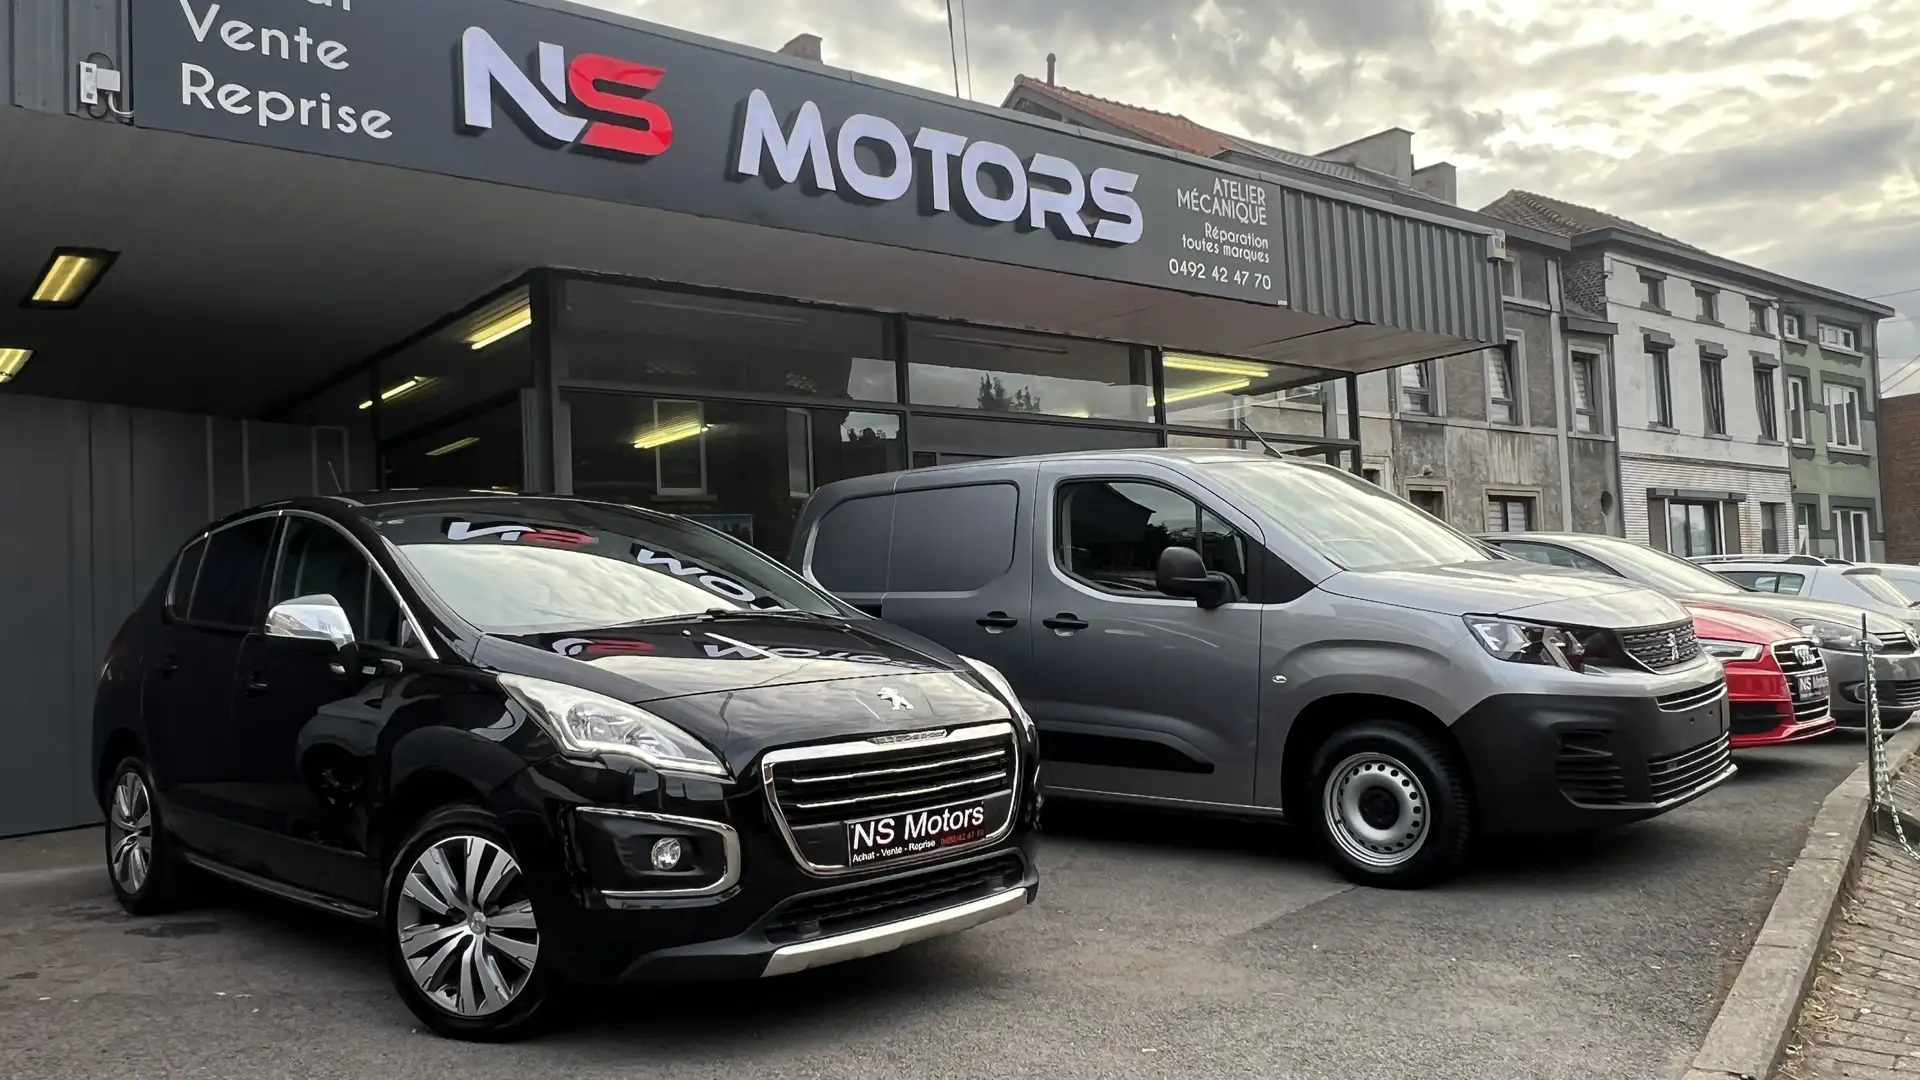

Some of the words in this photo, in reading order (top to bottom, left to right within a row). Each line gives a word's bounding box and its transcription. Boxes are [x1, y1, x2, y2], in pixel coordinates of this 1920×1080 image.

[179, 0, 350, 70] Vente
[181, 62, 393, 139] Reprise
[462, 26, 673, 156] NS
[738, 88, 1144, 244] MOTORS
[1177, 188, 1268, 226] MÉCANIQUE
[1213, 177, 1266, 207] ATELIER
[1182, 233, 1219, 254] toutes
[1223, 244, 1270, 264] marques
[1205, 222, 1269, 250] Réparation
[1168, 258, 1206, 279] 0492
[1211, 265, 1229, 283] 42
[1233, 270, 1250, 286] 47
[1254, 273, 1272, 290] 70
[853, 818, 895, 850] NS
[904, 806, 984, 840] Motors
[852, 851, 875, 863] Achat
